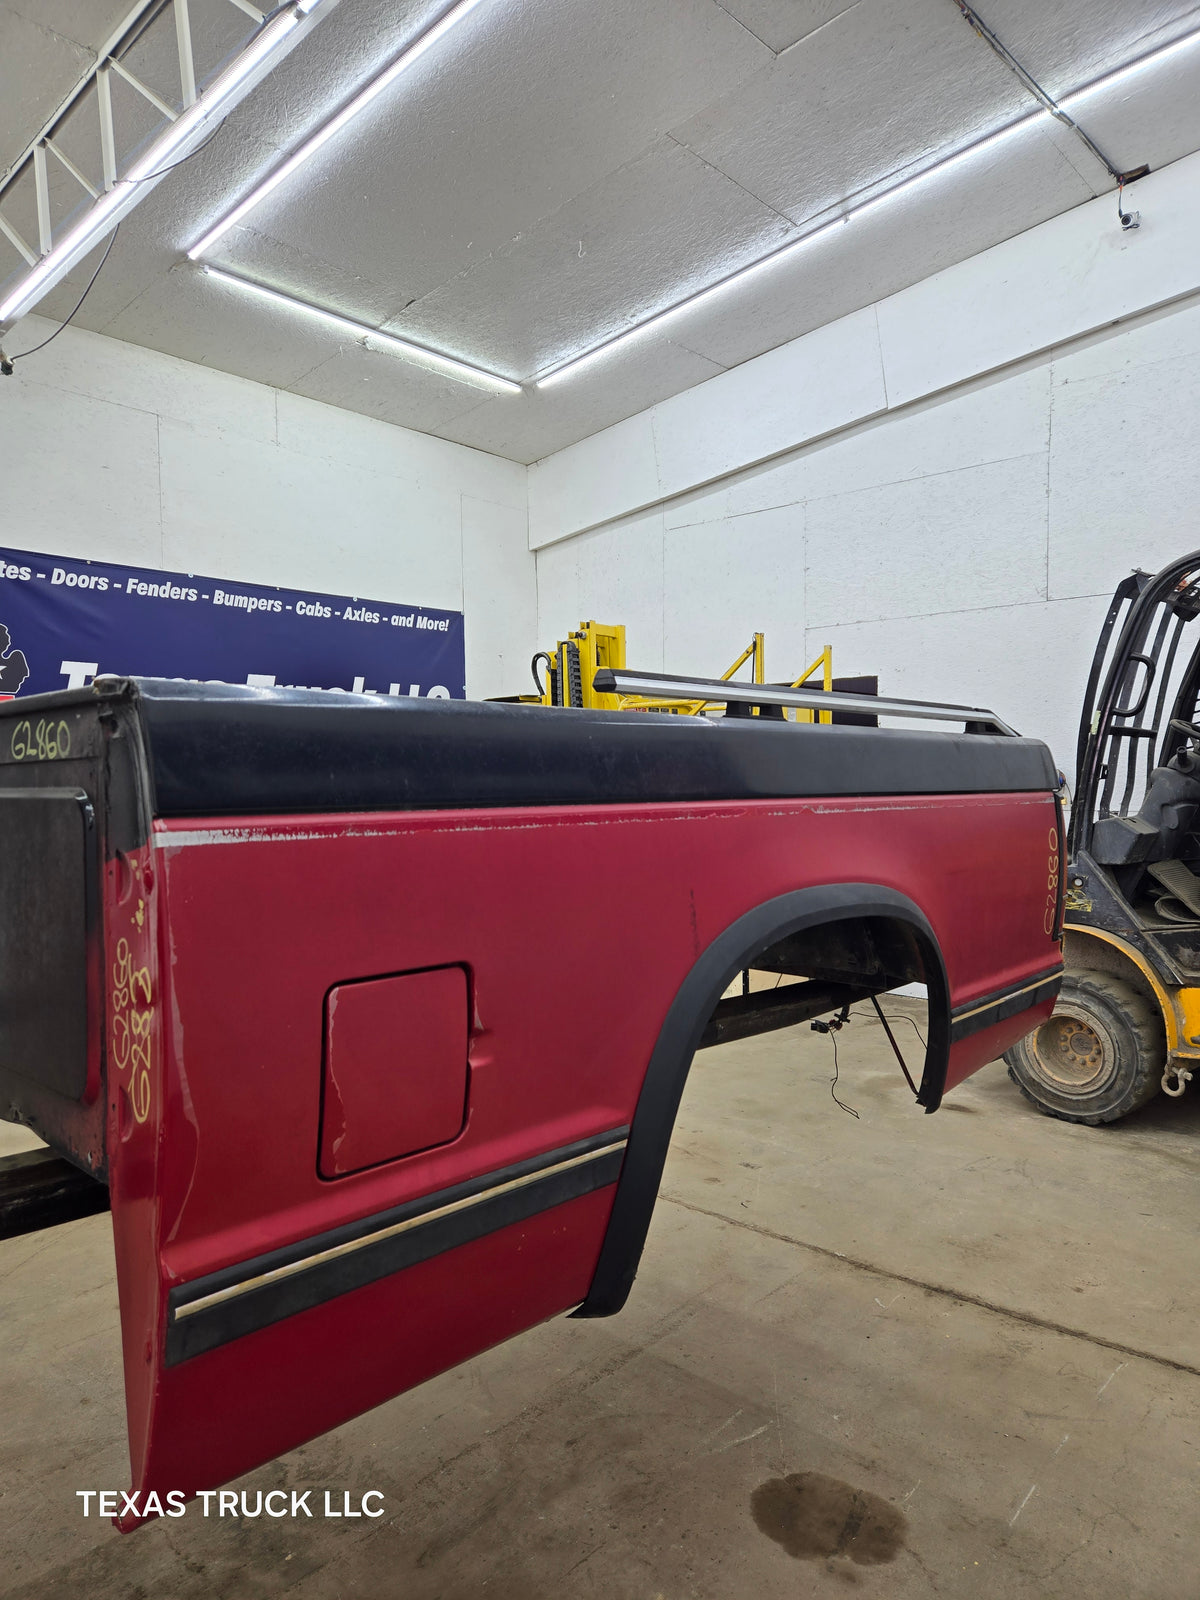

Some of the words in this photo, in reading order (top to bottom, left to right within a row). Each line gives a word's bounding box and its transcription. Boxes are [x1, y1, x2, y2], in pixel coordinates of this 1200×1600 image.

[50, 567, 109, 591] Doors
[126, 578, 198, 601] Fenders
[213, 589, 283, 613] Bumpers
[295, 600, 332, 618] Cabs
[342, 606, 380, 624] Axles
[391, 614, 414, 628] and
[416, 615, 450, 632] More!
[11, 718, 71, 760] 62860
